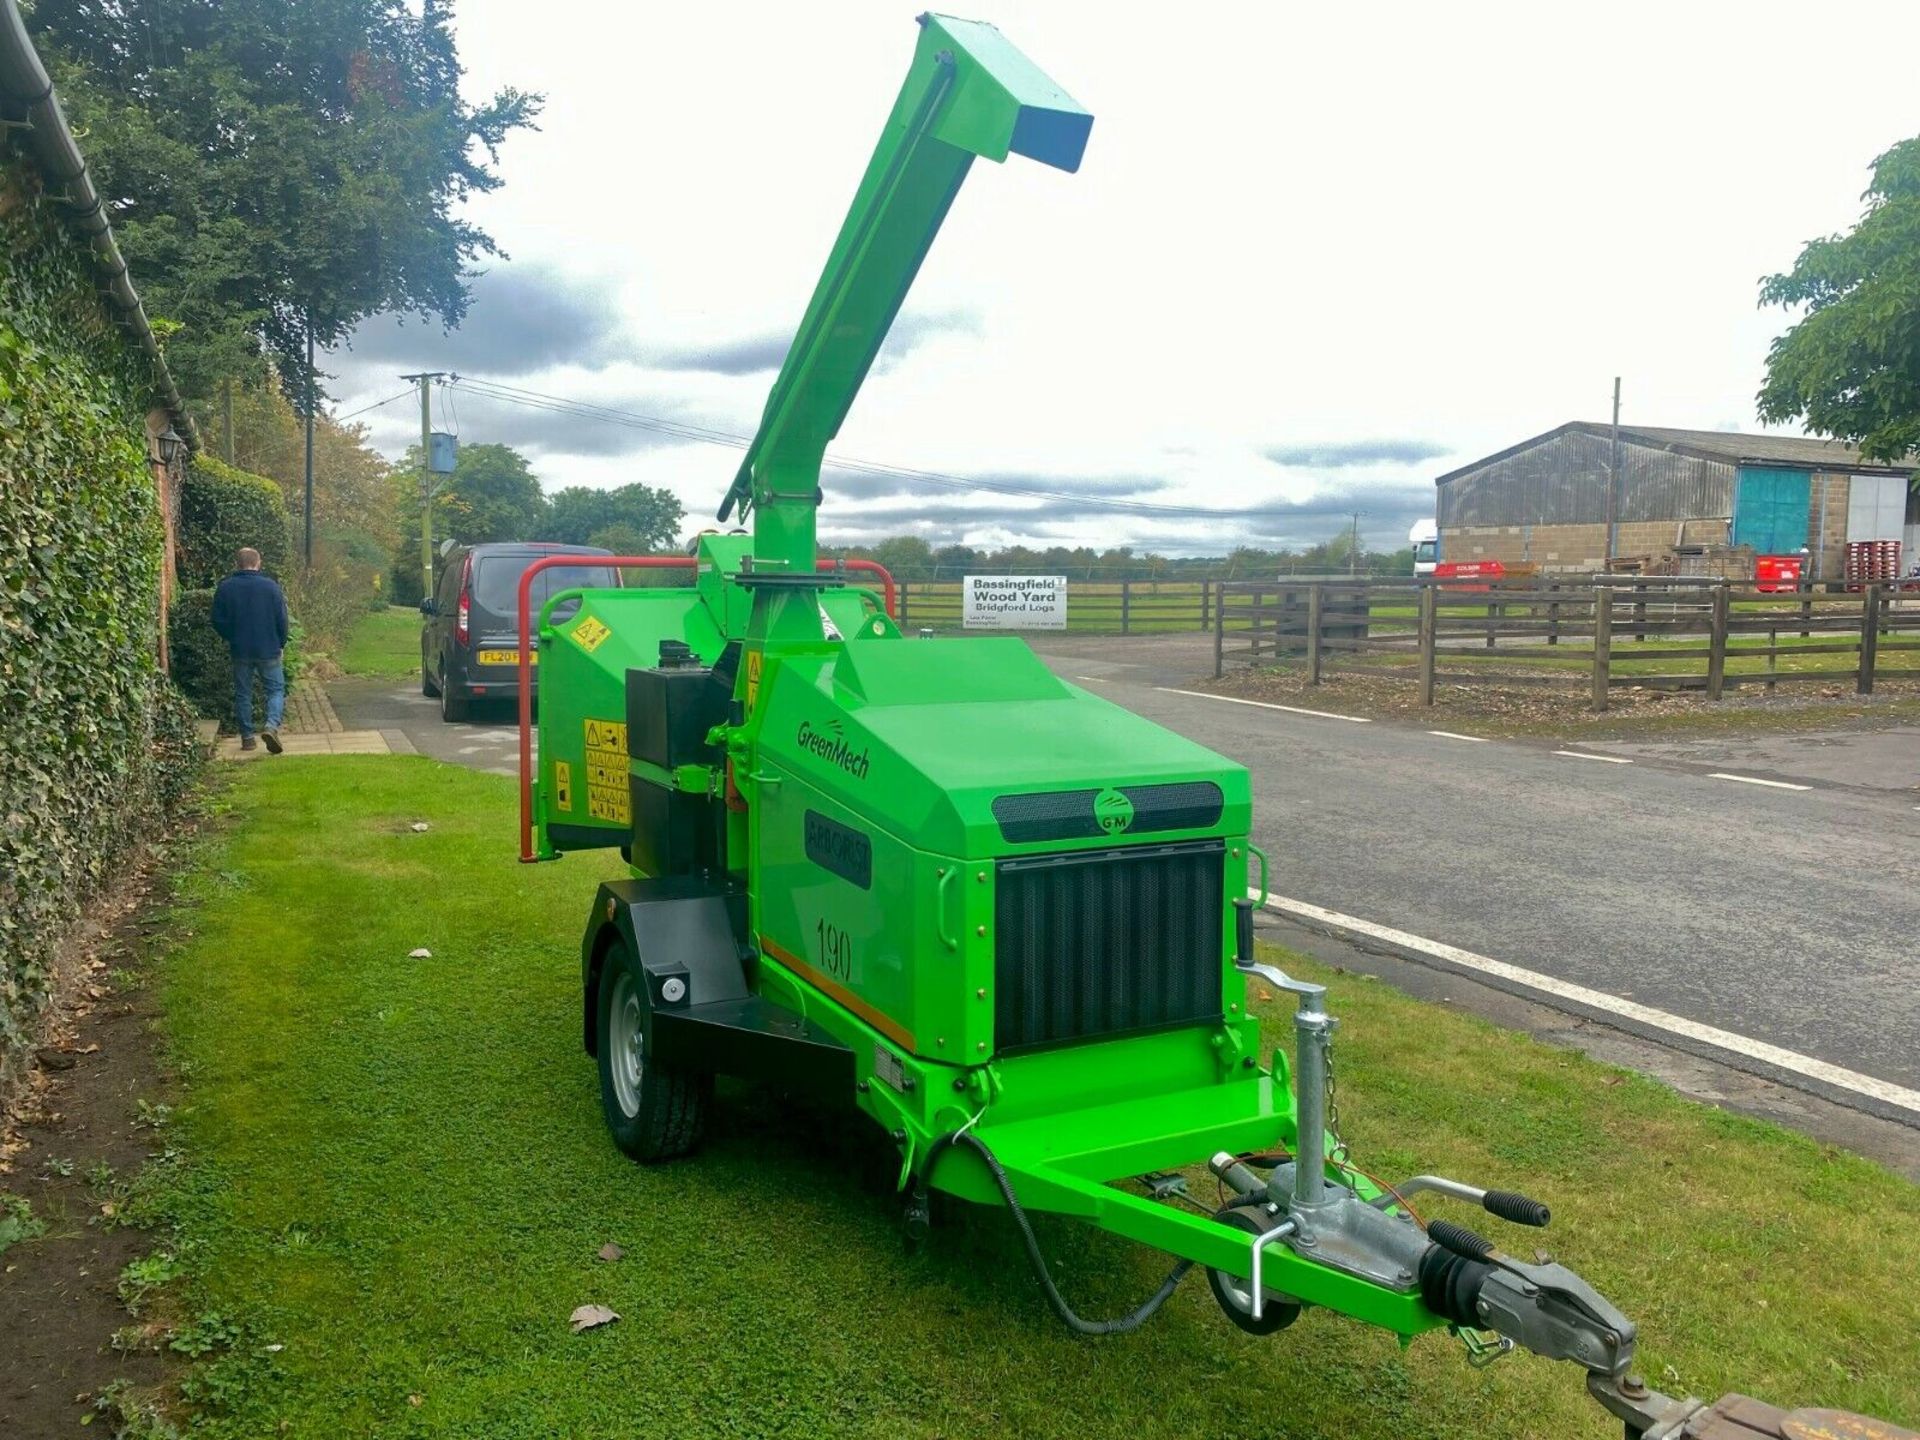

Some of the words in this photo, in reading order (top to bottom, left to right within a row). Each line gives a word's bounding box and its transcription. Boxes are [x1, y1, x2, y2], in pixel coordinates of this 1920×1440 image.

[974, 579, 1055, 591] Bassingfield
[974, 591, 1017, 602] Wood
[1021, 591, 1056, 602] Yard
[976, 603, 1026, 612] Bridgford
[1029, 604, 1055, 612] Logs
[485, 652, 511, 662] FL20
[797, 721, 870, 781] GreenMech
[818, 918, 851, 982] 190
